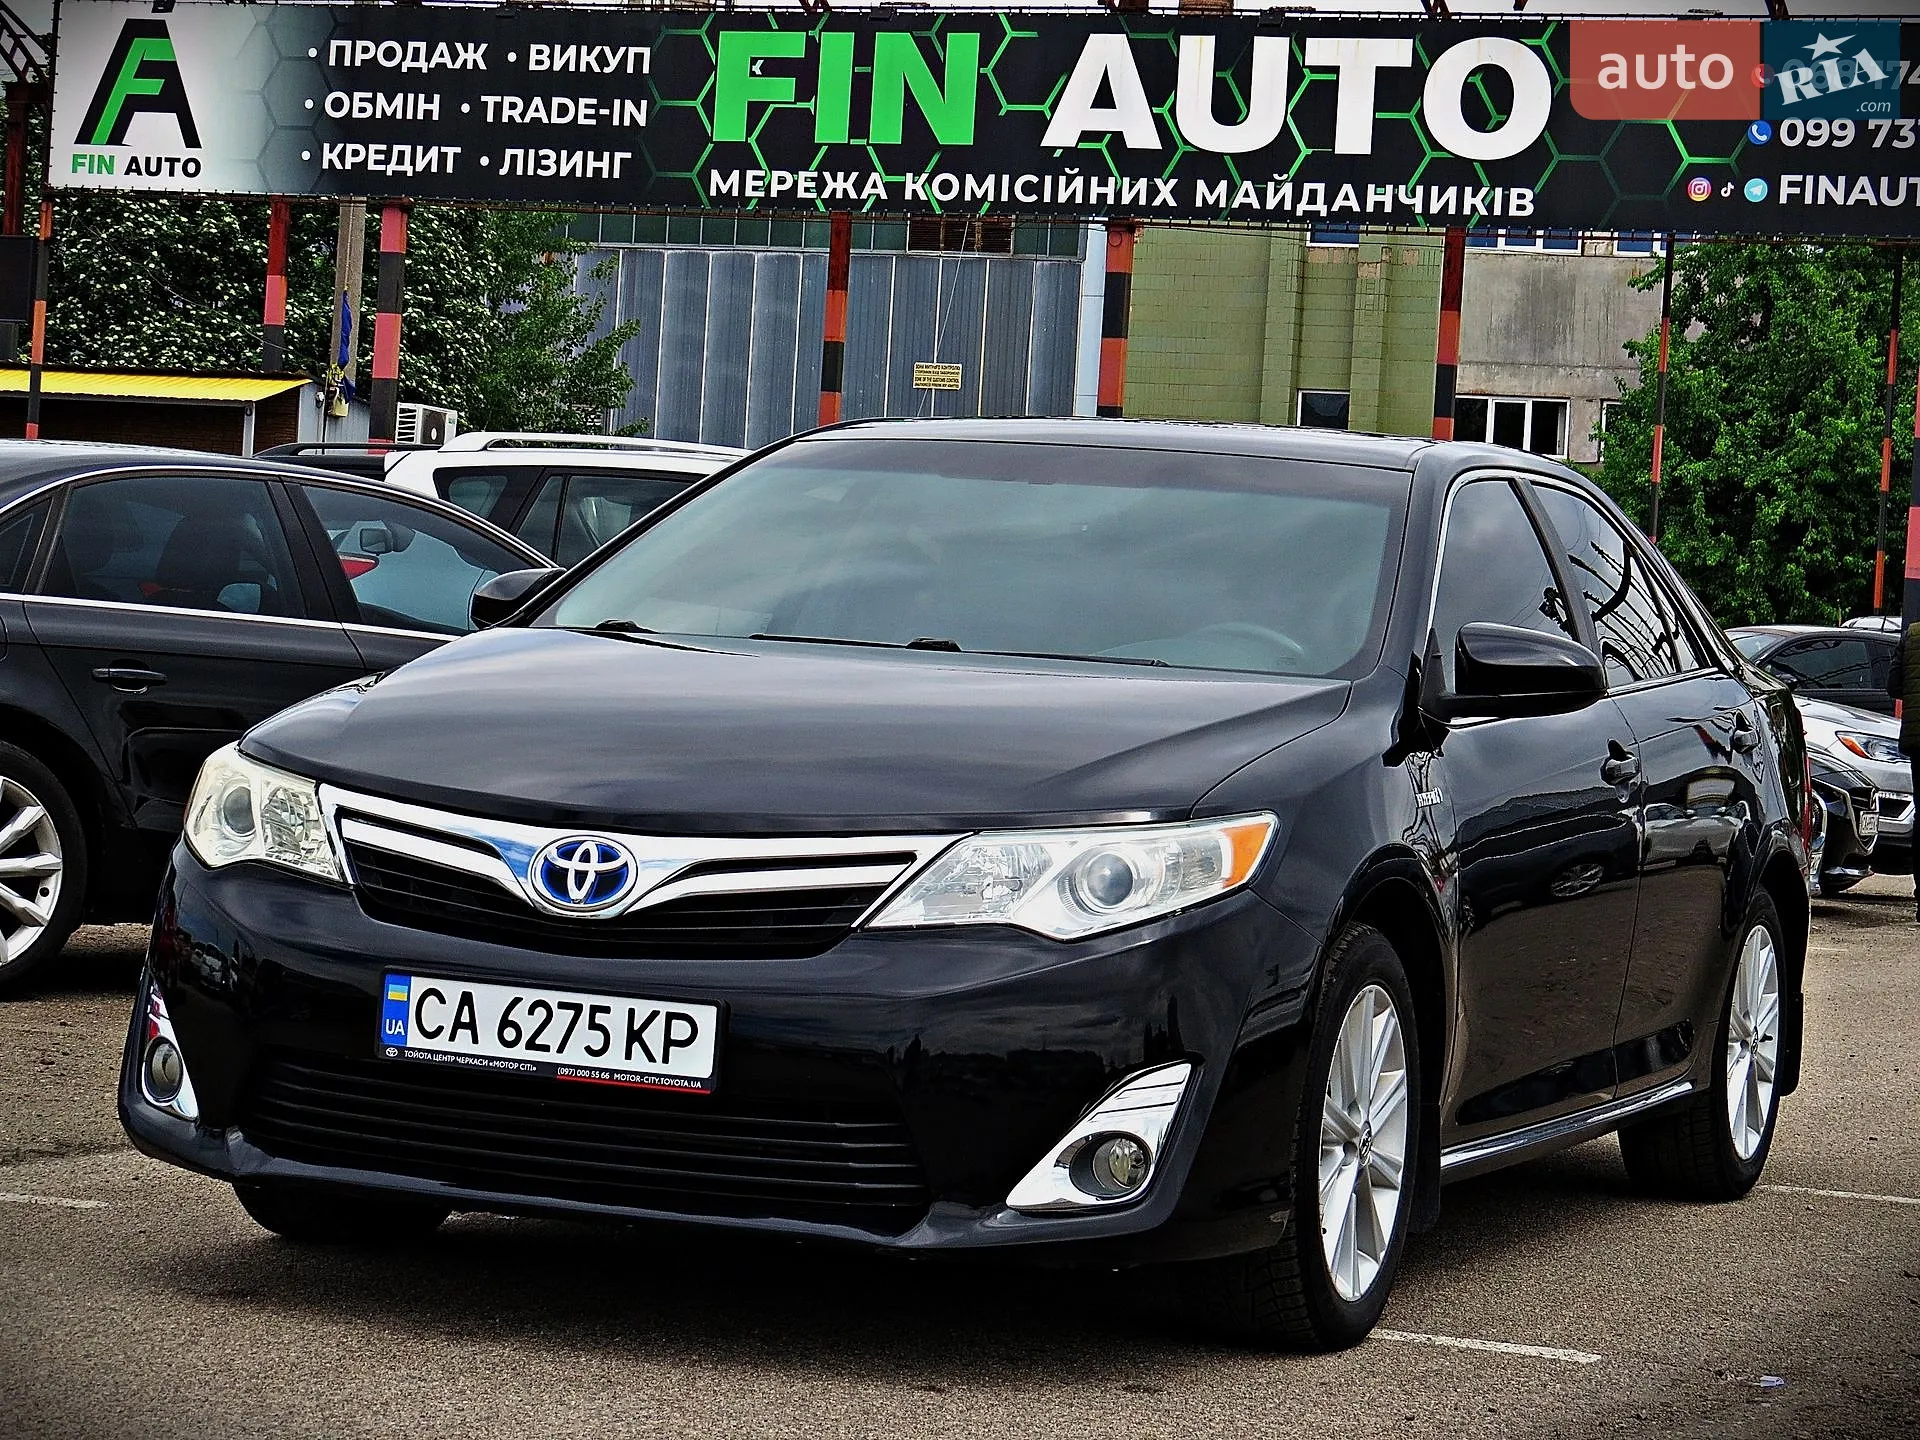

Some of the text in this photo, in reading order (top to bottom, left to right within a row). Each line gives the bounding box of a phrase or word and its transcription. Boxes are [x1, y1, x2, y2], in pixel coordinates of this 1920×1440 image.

[328, 39, 651, 74] ПРОДАЖ ВИКУП
[324, 91, 648, 127] ОБМІН TRADE-IN
[712, 30, 1552, 161] FIN AUTO
[1779, 117, 1920, 149] 099 73
[71, 153, 202, 179] FIN AUTO
[321, 142, 632, 179] КРЕДИТ ЛІЗИНГ
[709, 167, 1535, 217] МЕРЕЖА КОМІСІЙНИХ МАЙДАНЧИКІВ
[385, 1018, 405, 1037] UA
[414, 987, 699, 1065] CA 6275 KP
[404, 1050, 432, 1060] ТОЙОТА
[433, 1053, 456, 1063] ЦЕНТР
[456, 1056, 488, 1067] ЧЕРКАСИ
[556, 1066, 702, 1089] (097) 000 55 66 MOTOR-CITY.TOYOTA.UA
